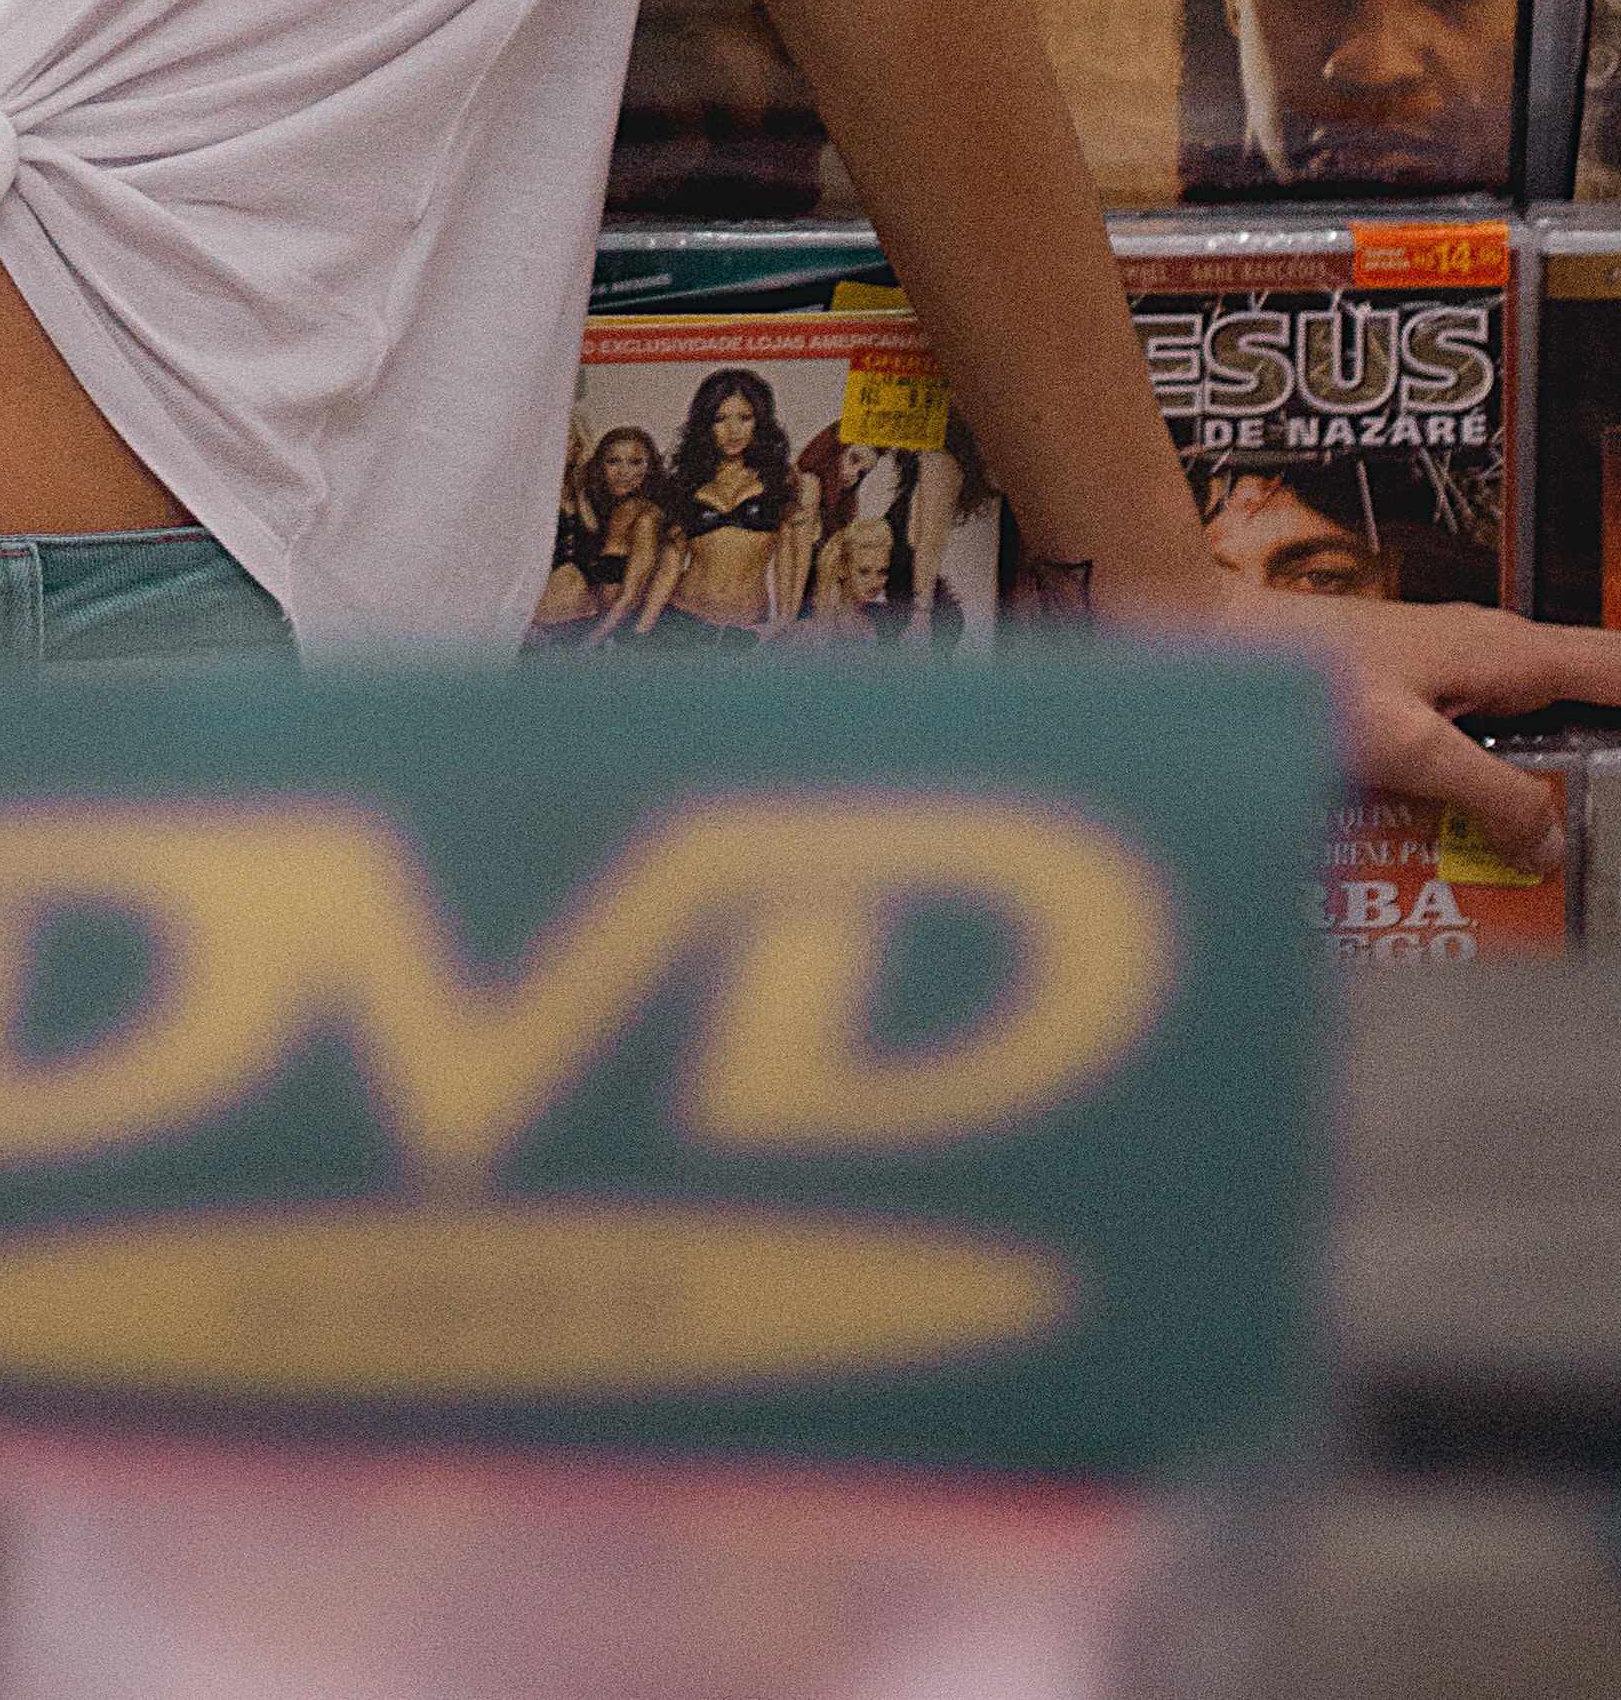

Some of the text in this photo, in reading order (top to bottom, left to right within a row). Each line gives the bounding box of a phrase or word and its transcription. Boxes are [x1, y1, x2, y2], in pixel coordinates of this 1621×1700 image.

[599, 336, 741, 355] EXCLUSIVIDADE
[746, 335, 804, 352] LOJAS
[1203, 410, 1488, 449] DE NAZARÉ
